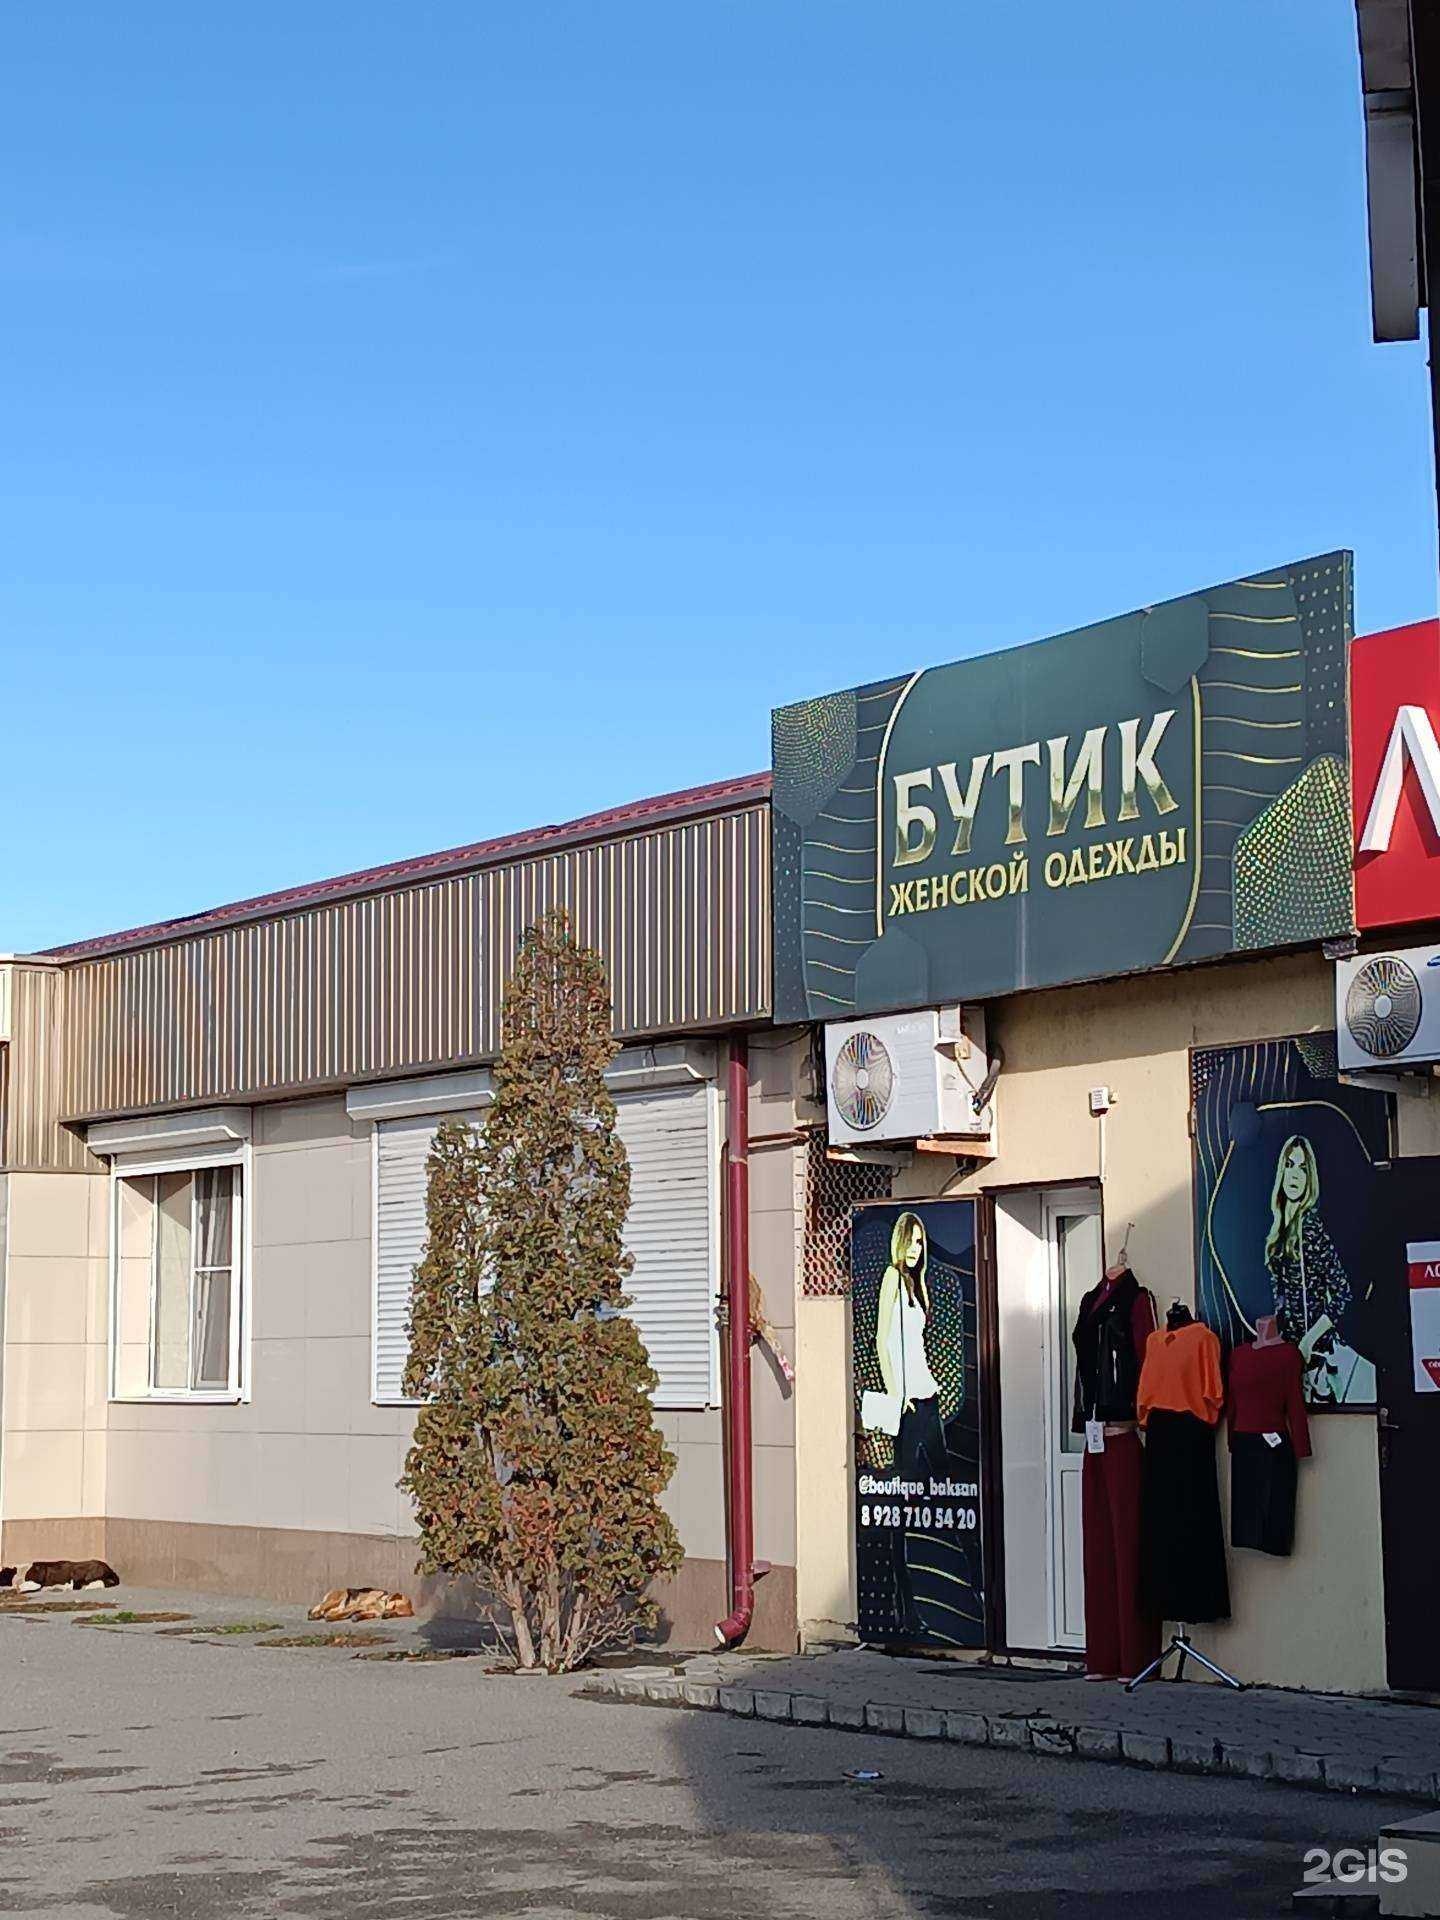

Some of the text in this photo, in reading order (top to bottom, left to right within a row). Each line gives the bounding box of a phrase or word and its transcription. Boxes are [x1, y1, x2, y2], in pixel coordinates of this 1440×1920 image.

[892, 709, 1179, 867] БУТИК
[888, 827, 1187, 916] ЖЕНСКОЙ ОДЕЖДЫ
[859, 1475, 977, 1501] @boutique_baksan
[861, 1505, 976, 1530] 8 928 710 54 20
